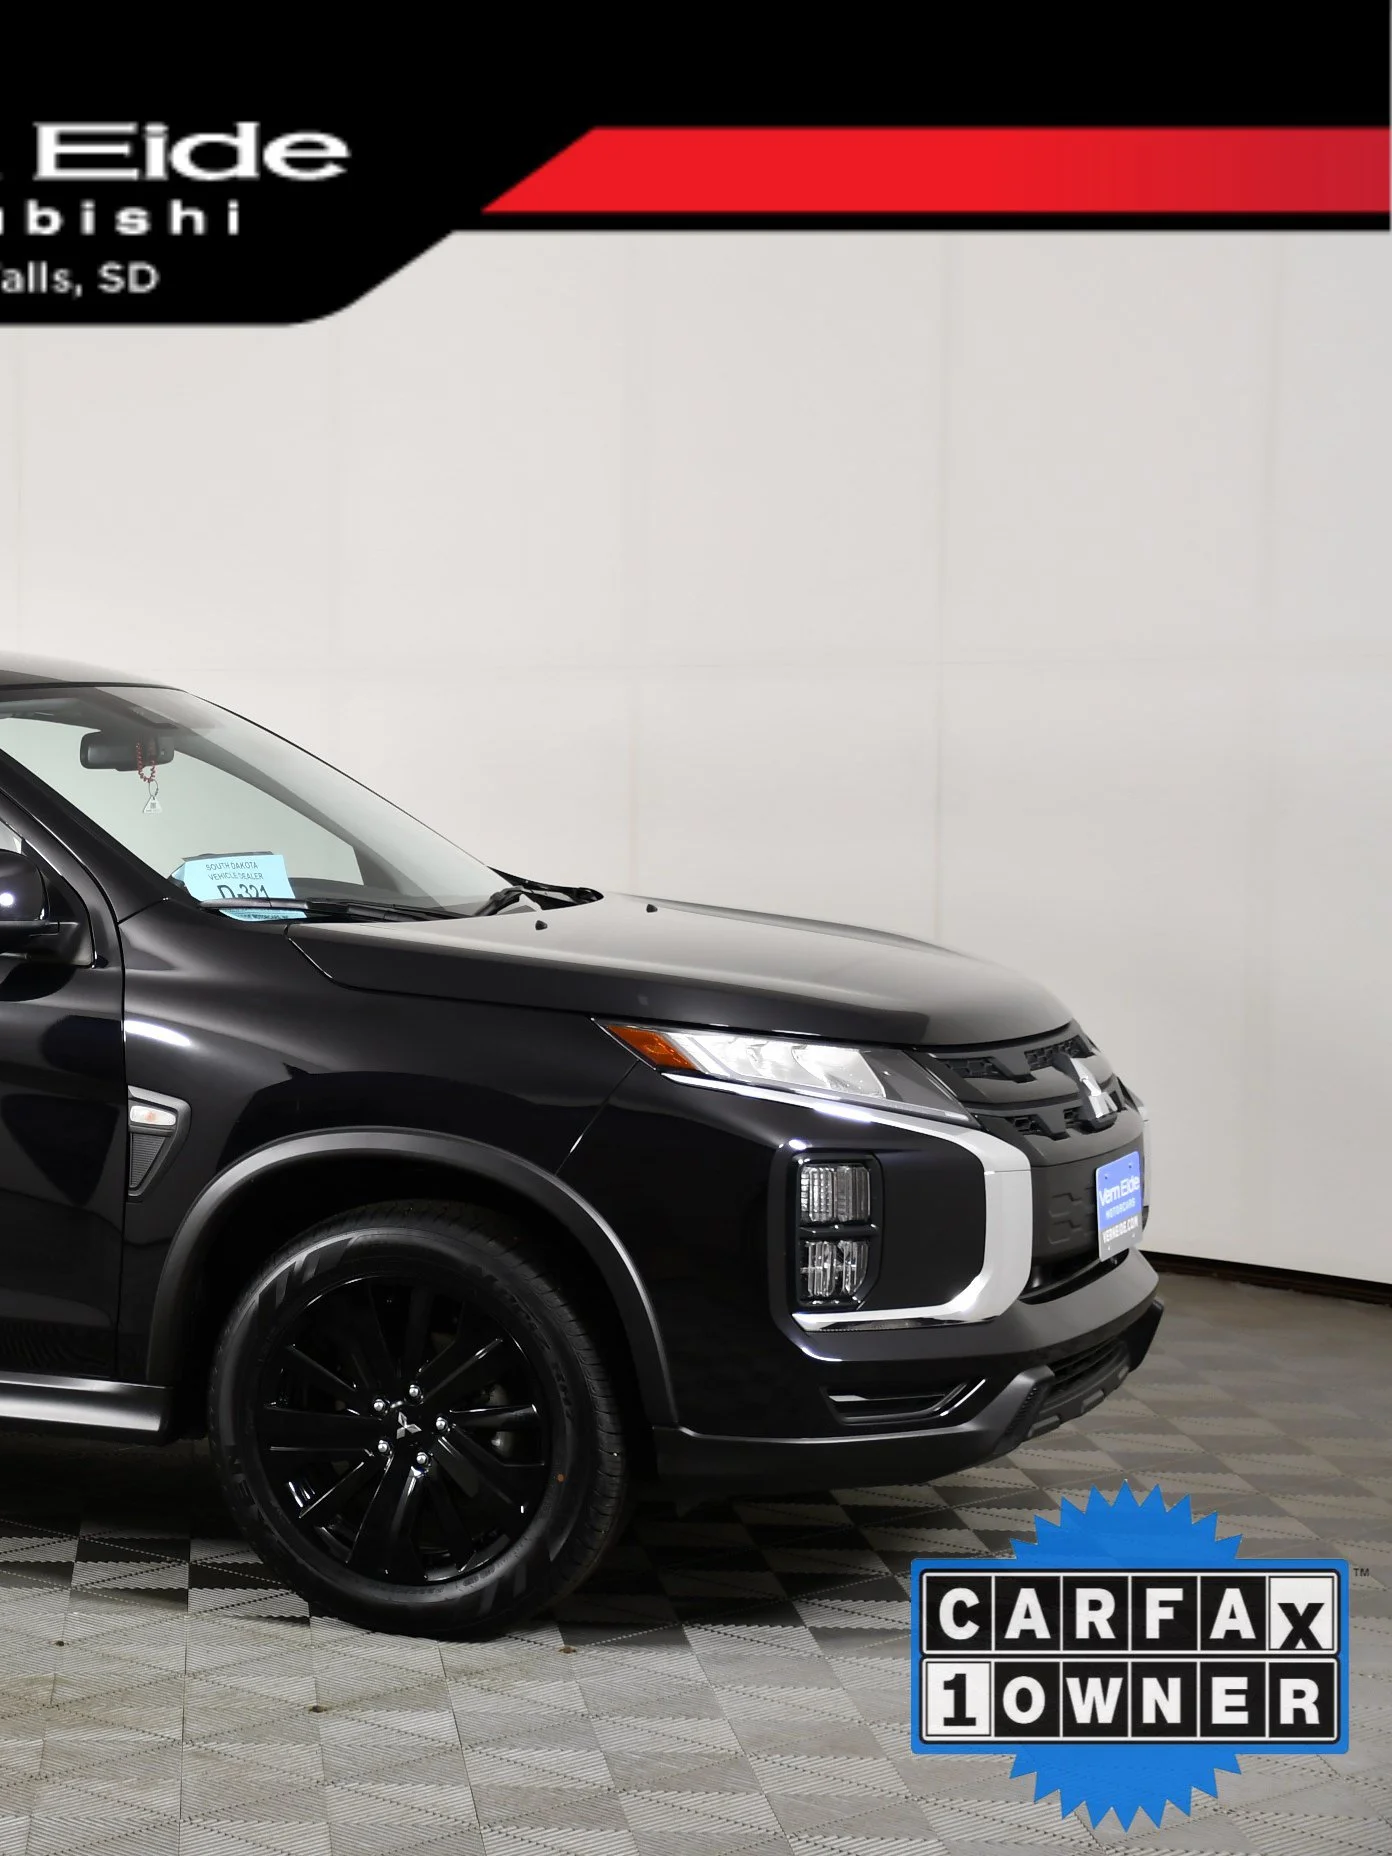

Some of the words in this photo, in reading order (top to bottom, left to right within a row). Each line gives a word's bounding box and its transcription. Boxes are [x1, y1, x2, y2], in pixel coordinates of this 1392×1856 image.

[206, 862, 230, 870] SOUTH
[231, 861, 259, 869] DAKOTA
[1099, 1185, 1121, 1206] Vern
[1120, 1176, 1140, 1197] Eide
